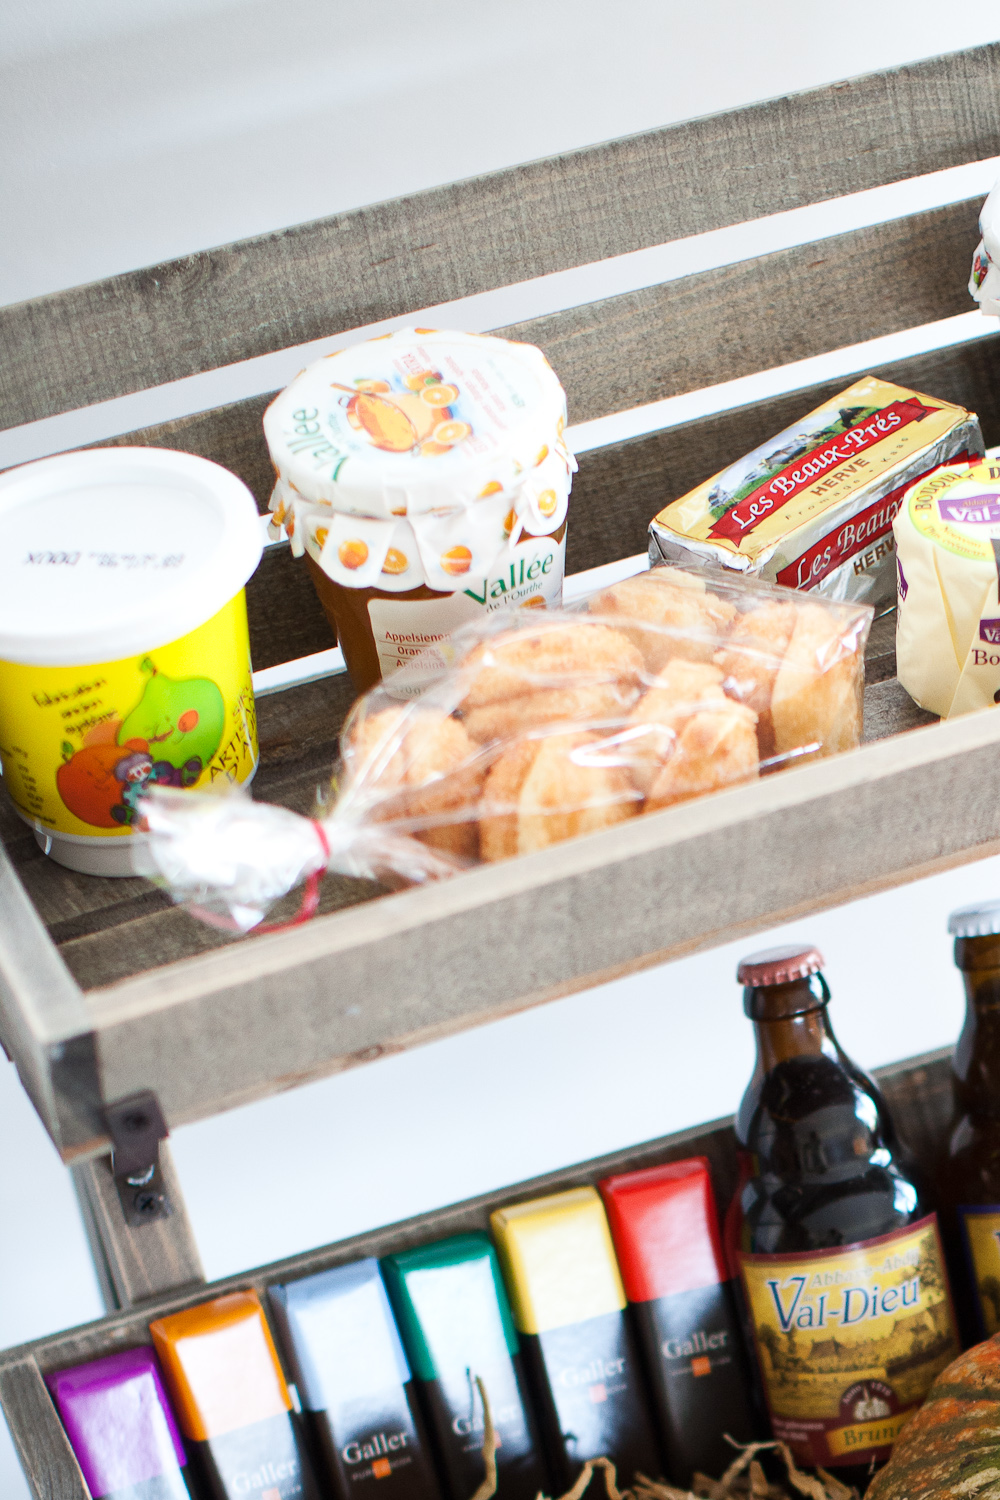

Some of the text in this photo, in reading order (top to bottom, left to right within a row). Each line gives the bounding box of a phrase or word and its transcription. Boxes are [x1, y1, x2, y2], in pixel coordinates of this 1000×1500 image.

[731, 409, 902, 530] Les Beaux-Prés
[811, 458, 871, 496] HERVE
[795, 546, 831, 590] Les
[853, 537, 895, 576] HERV
[463, 553, 554, 605] Vallée
[486, 581, 543, 613] de l'Ourthe
[768, 1277, 918, 1329] Val-Dieu
[661, 1331, 728, 1360] Galler
[559, 1357, 626, 1388] Galler
[342, 1432, 409, 1464] Galler
[231, 1459, 297, 1494] Galler
